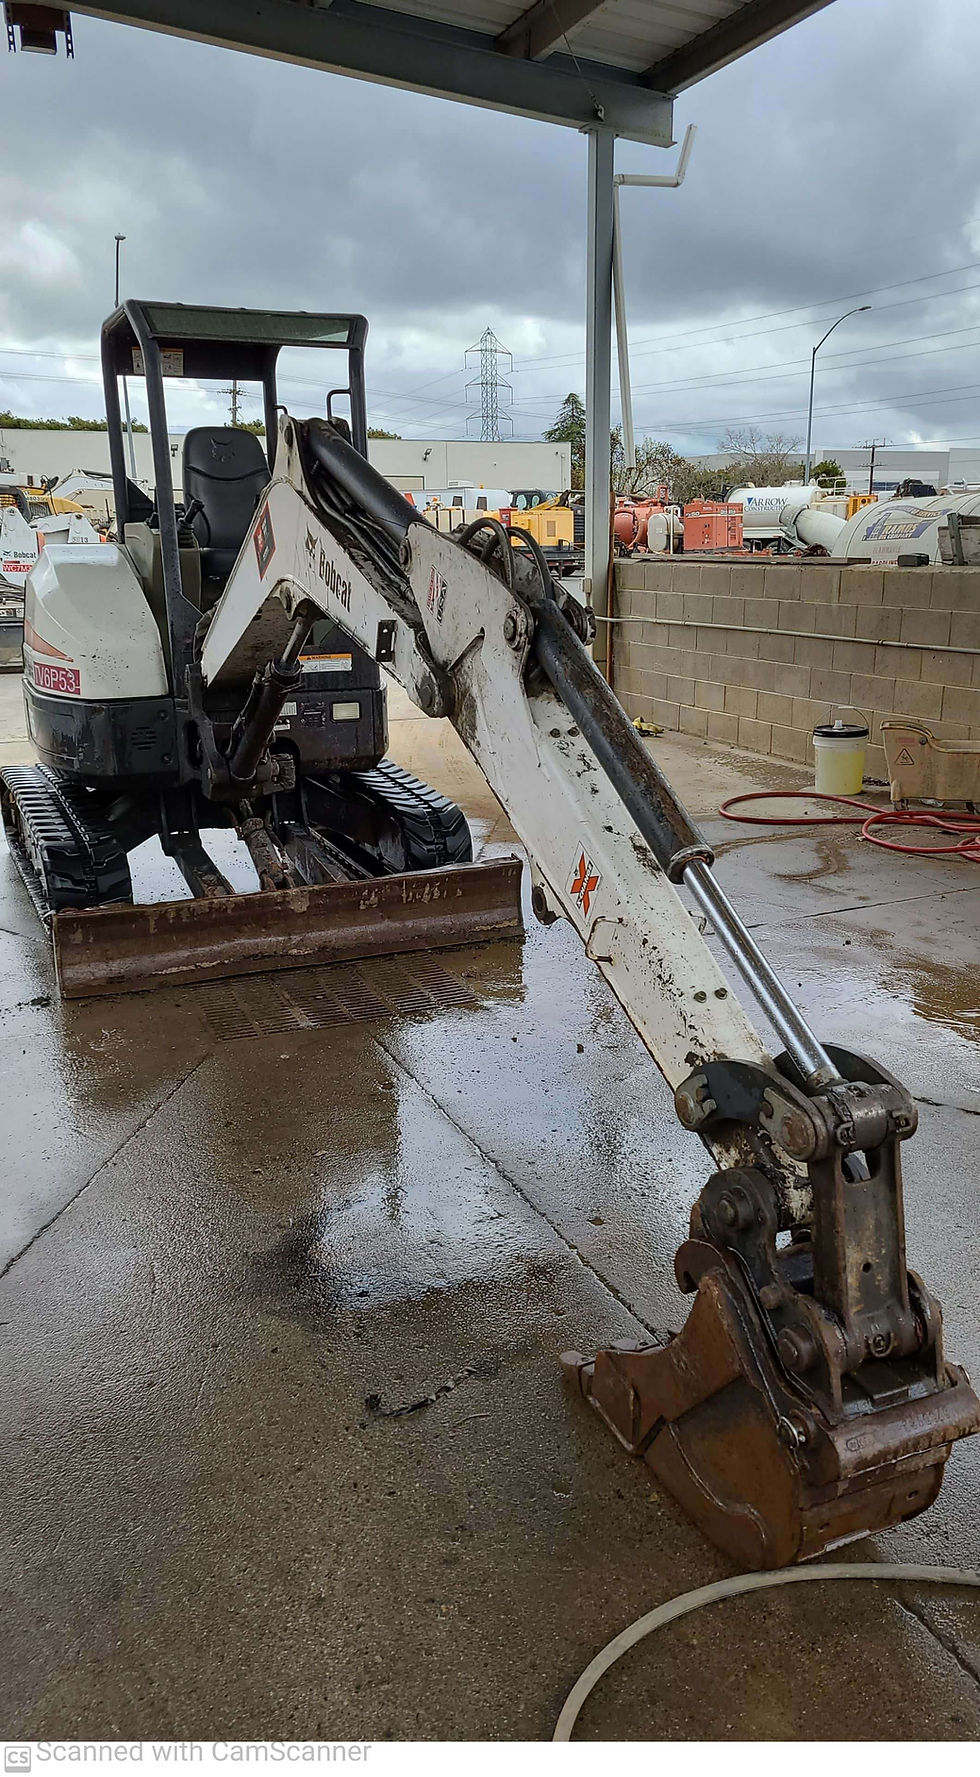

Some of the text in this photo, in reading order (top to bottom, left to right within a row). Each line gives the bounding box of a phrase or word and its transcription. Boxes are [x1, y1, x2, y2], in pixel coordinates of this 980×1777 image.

[749, 498, 788, 506] ARROW
[882, 523, 919, 535] RAMOS
[13, 551, 37, 559] Bobcat
[318, 550, 352, 613] Bobcat
[34, 664, 76, 692] TV6P53
